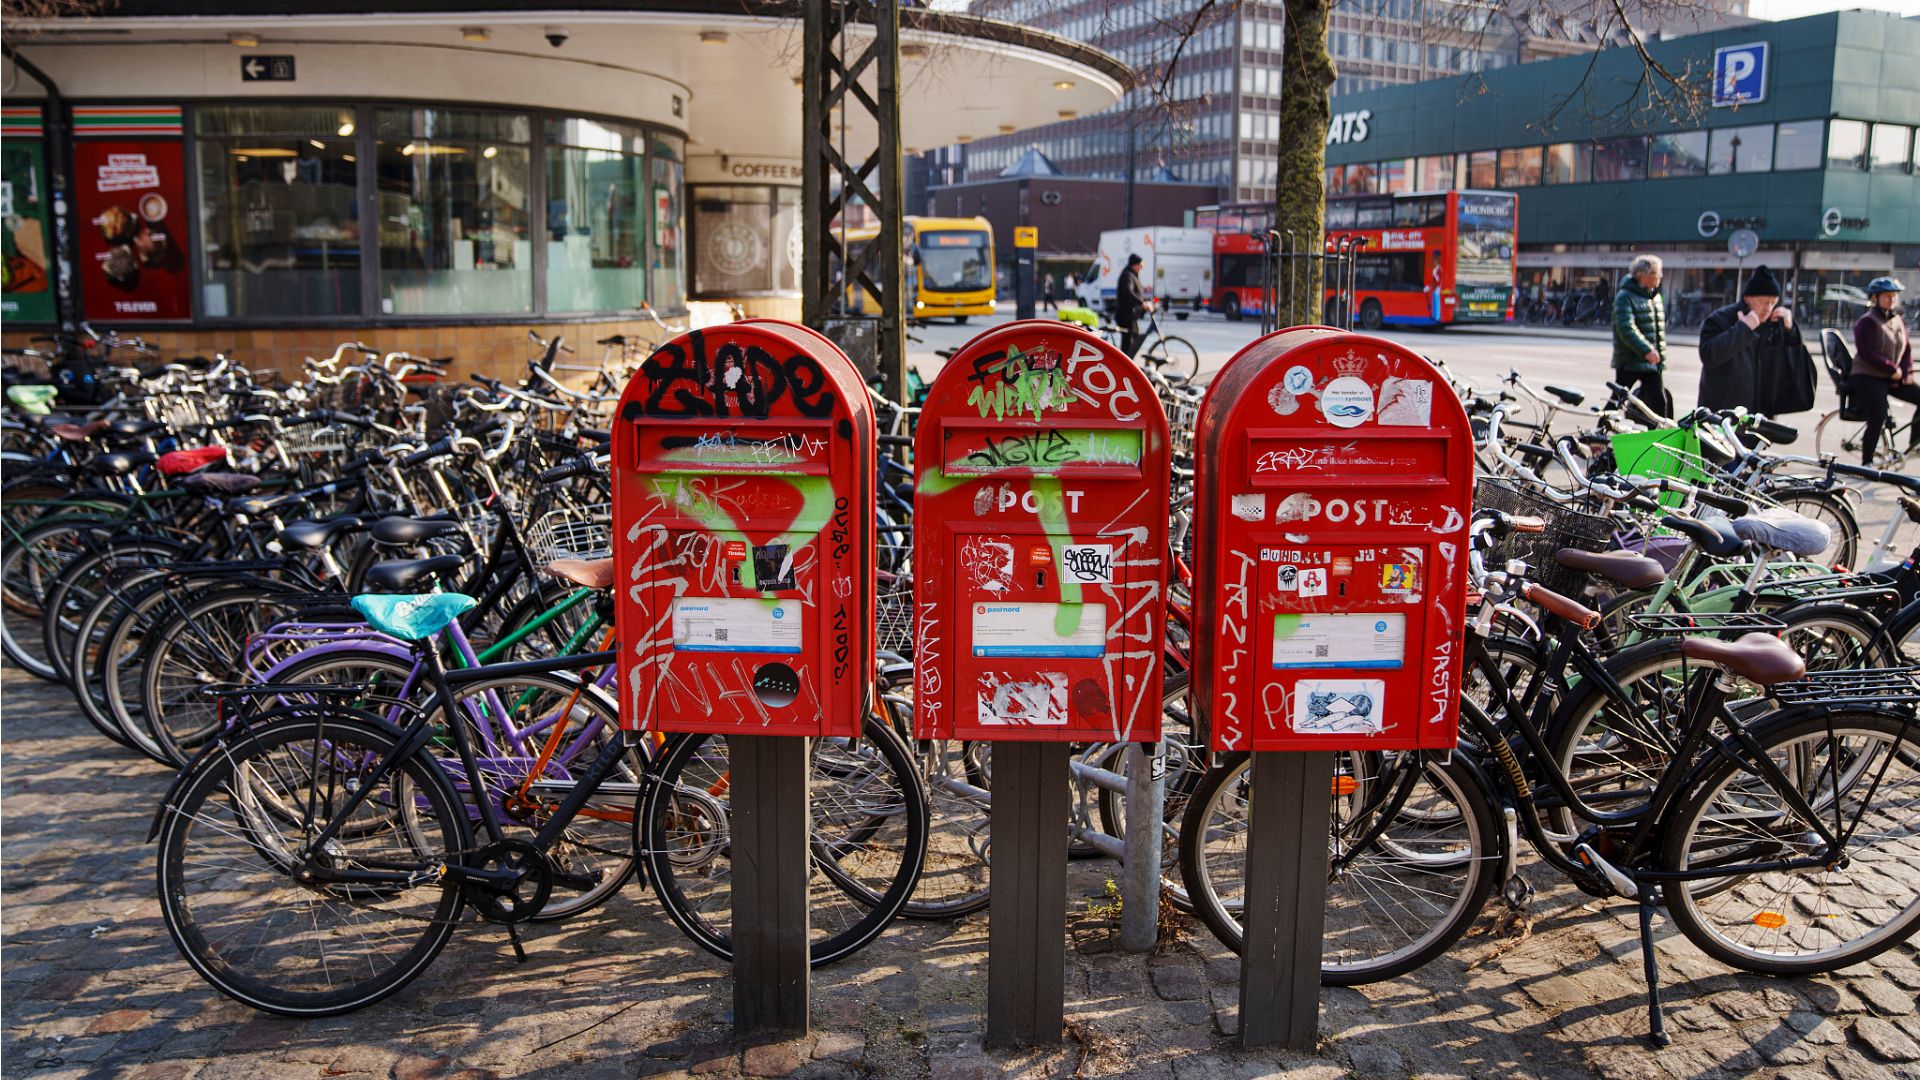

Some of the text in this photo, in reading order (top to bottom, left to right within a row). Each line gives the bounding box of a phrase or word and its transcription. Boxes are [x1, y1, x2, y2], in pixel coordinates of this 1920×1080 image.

[1723, 51, 1755, 95] P
[1325, 109, 1371, 145] ATS
[731, 163, 787, 178] COFFEE
[1464, 203, 1509, 216] KRONBORG
[998, 491, 1085, 513] POST
[1303, 498, 1388, 525] POST
[1429, 640, 1452, 723] PASTA
